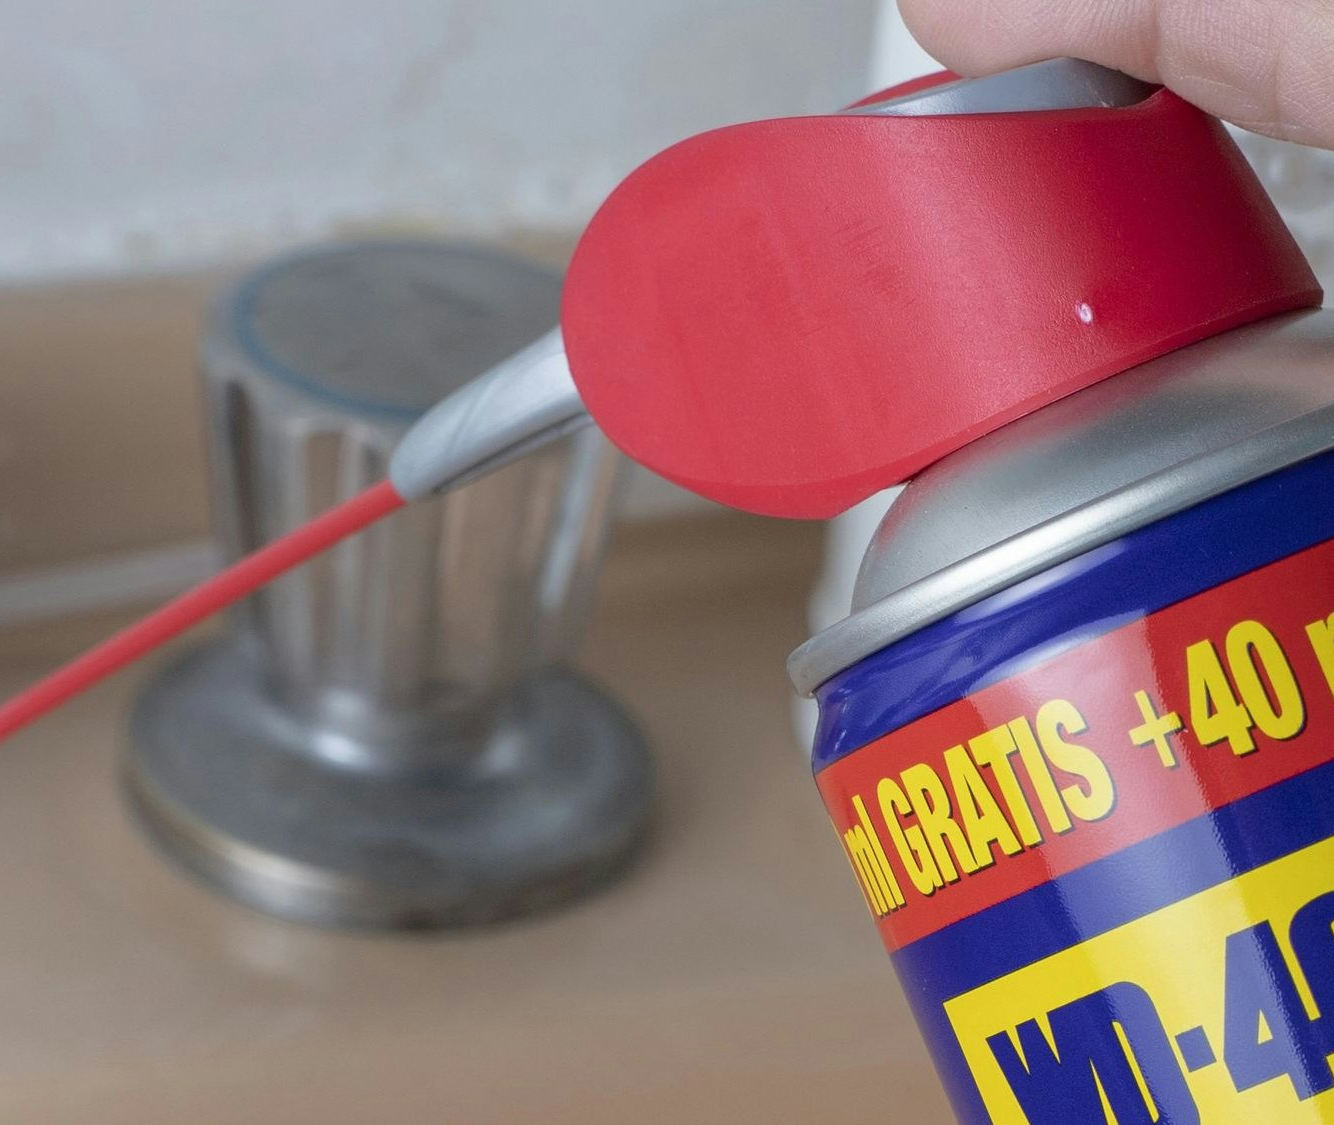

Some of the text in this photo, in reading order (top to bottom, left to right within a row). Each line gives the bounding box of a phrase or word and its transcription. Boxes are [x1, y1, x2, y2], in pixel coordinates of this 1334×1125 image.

[844, 794, 906, 917] ml
[877, 699, 1116, 896] GRATIS
[1129, 620, 1306, 770] +40
